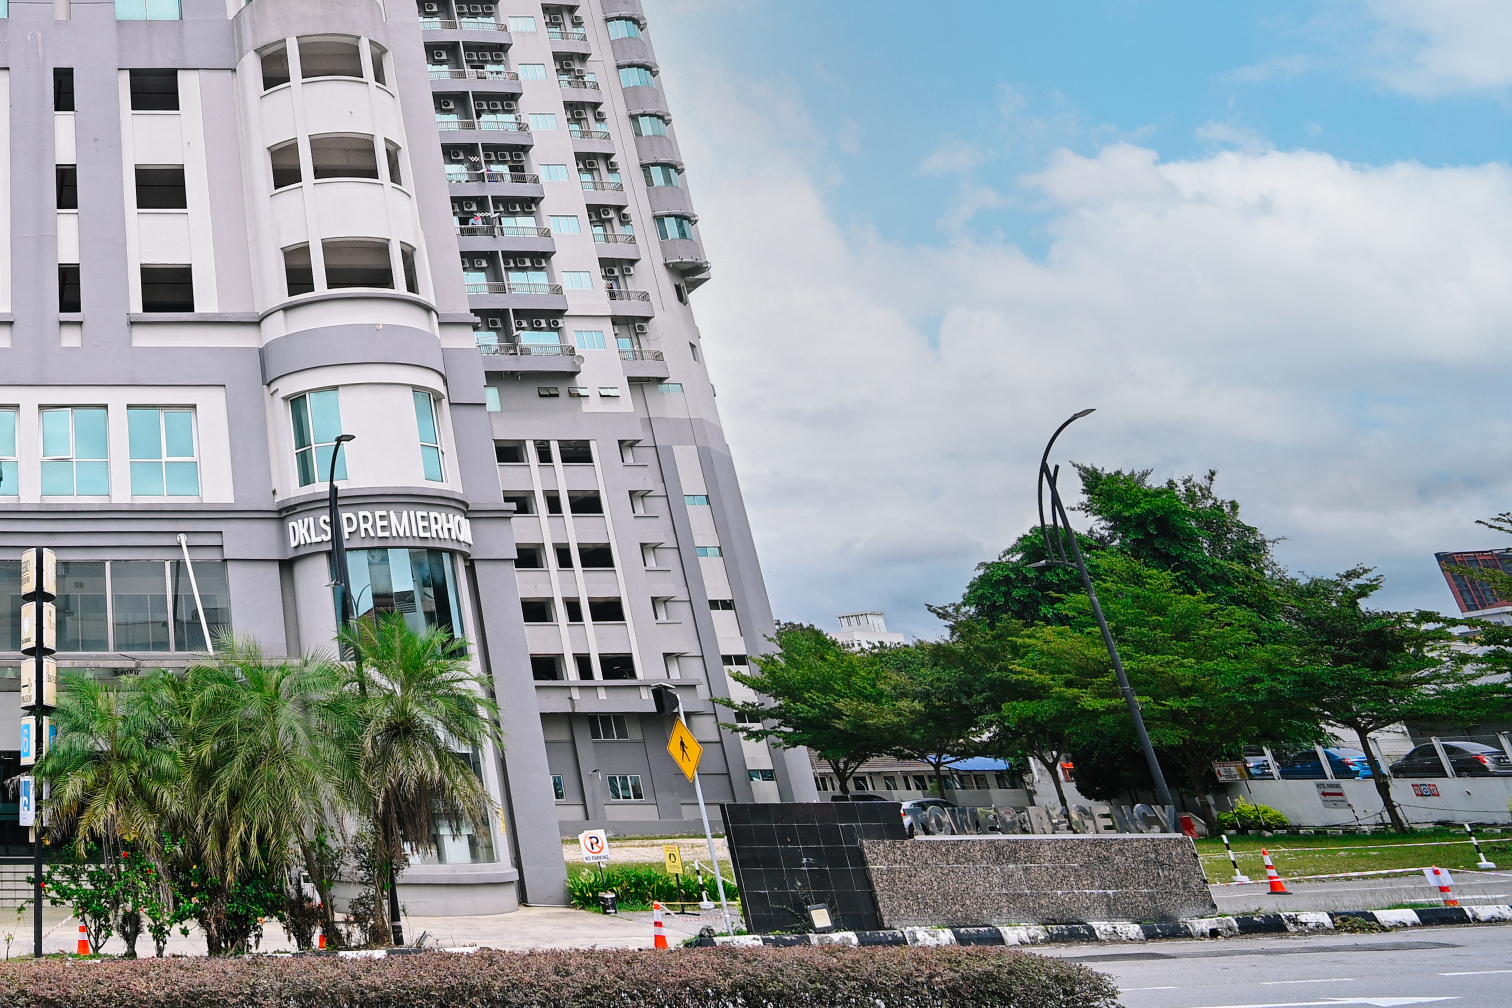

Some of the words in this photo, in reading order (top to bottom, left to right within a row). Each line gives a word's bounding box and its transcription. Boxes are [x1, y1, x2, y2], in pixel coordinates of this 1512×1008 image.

[288, 514, 332, 548] DKLS
[904, 805, 1027, 835] TOWER
[1026, 803, 1176, 834] REGENCY
